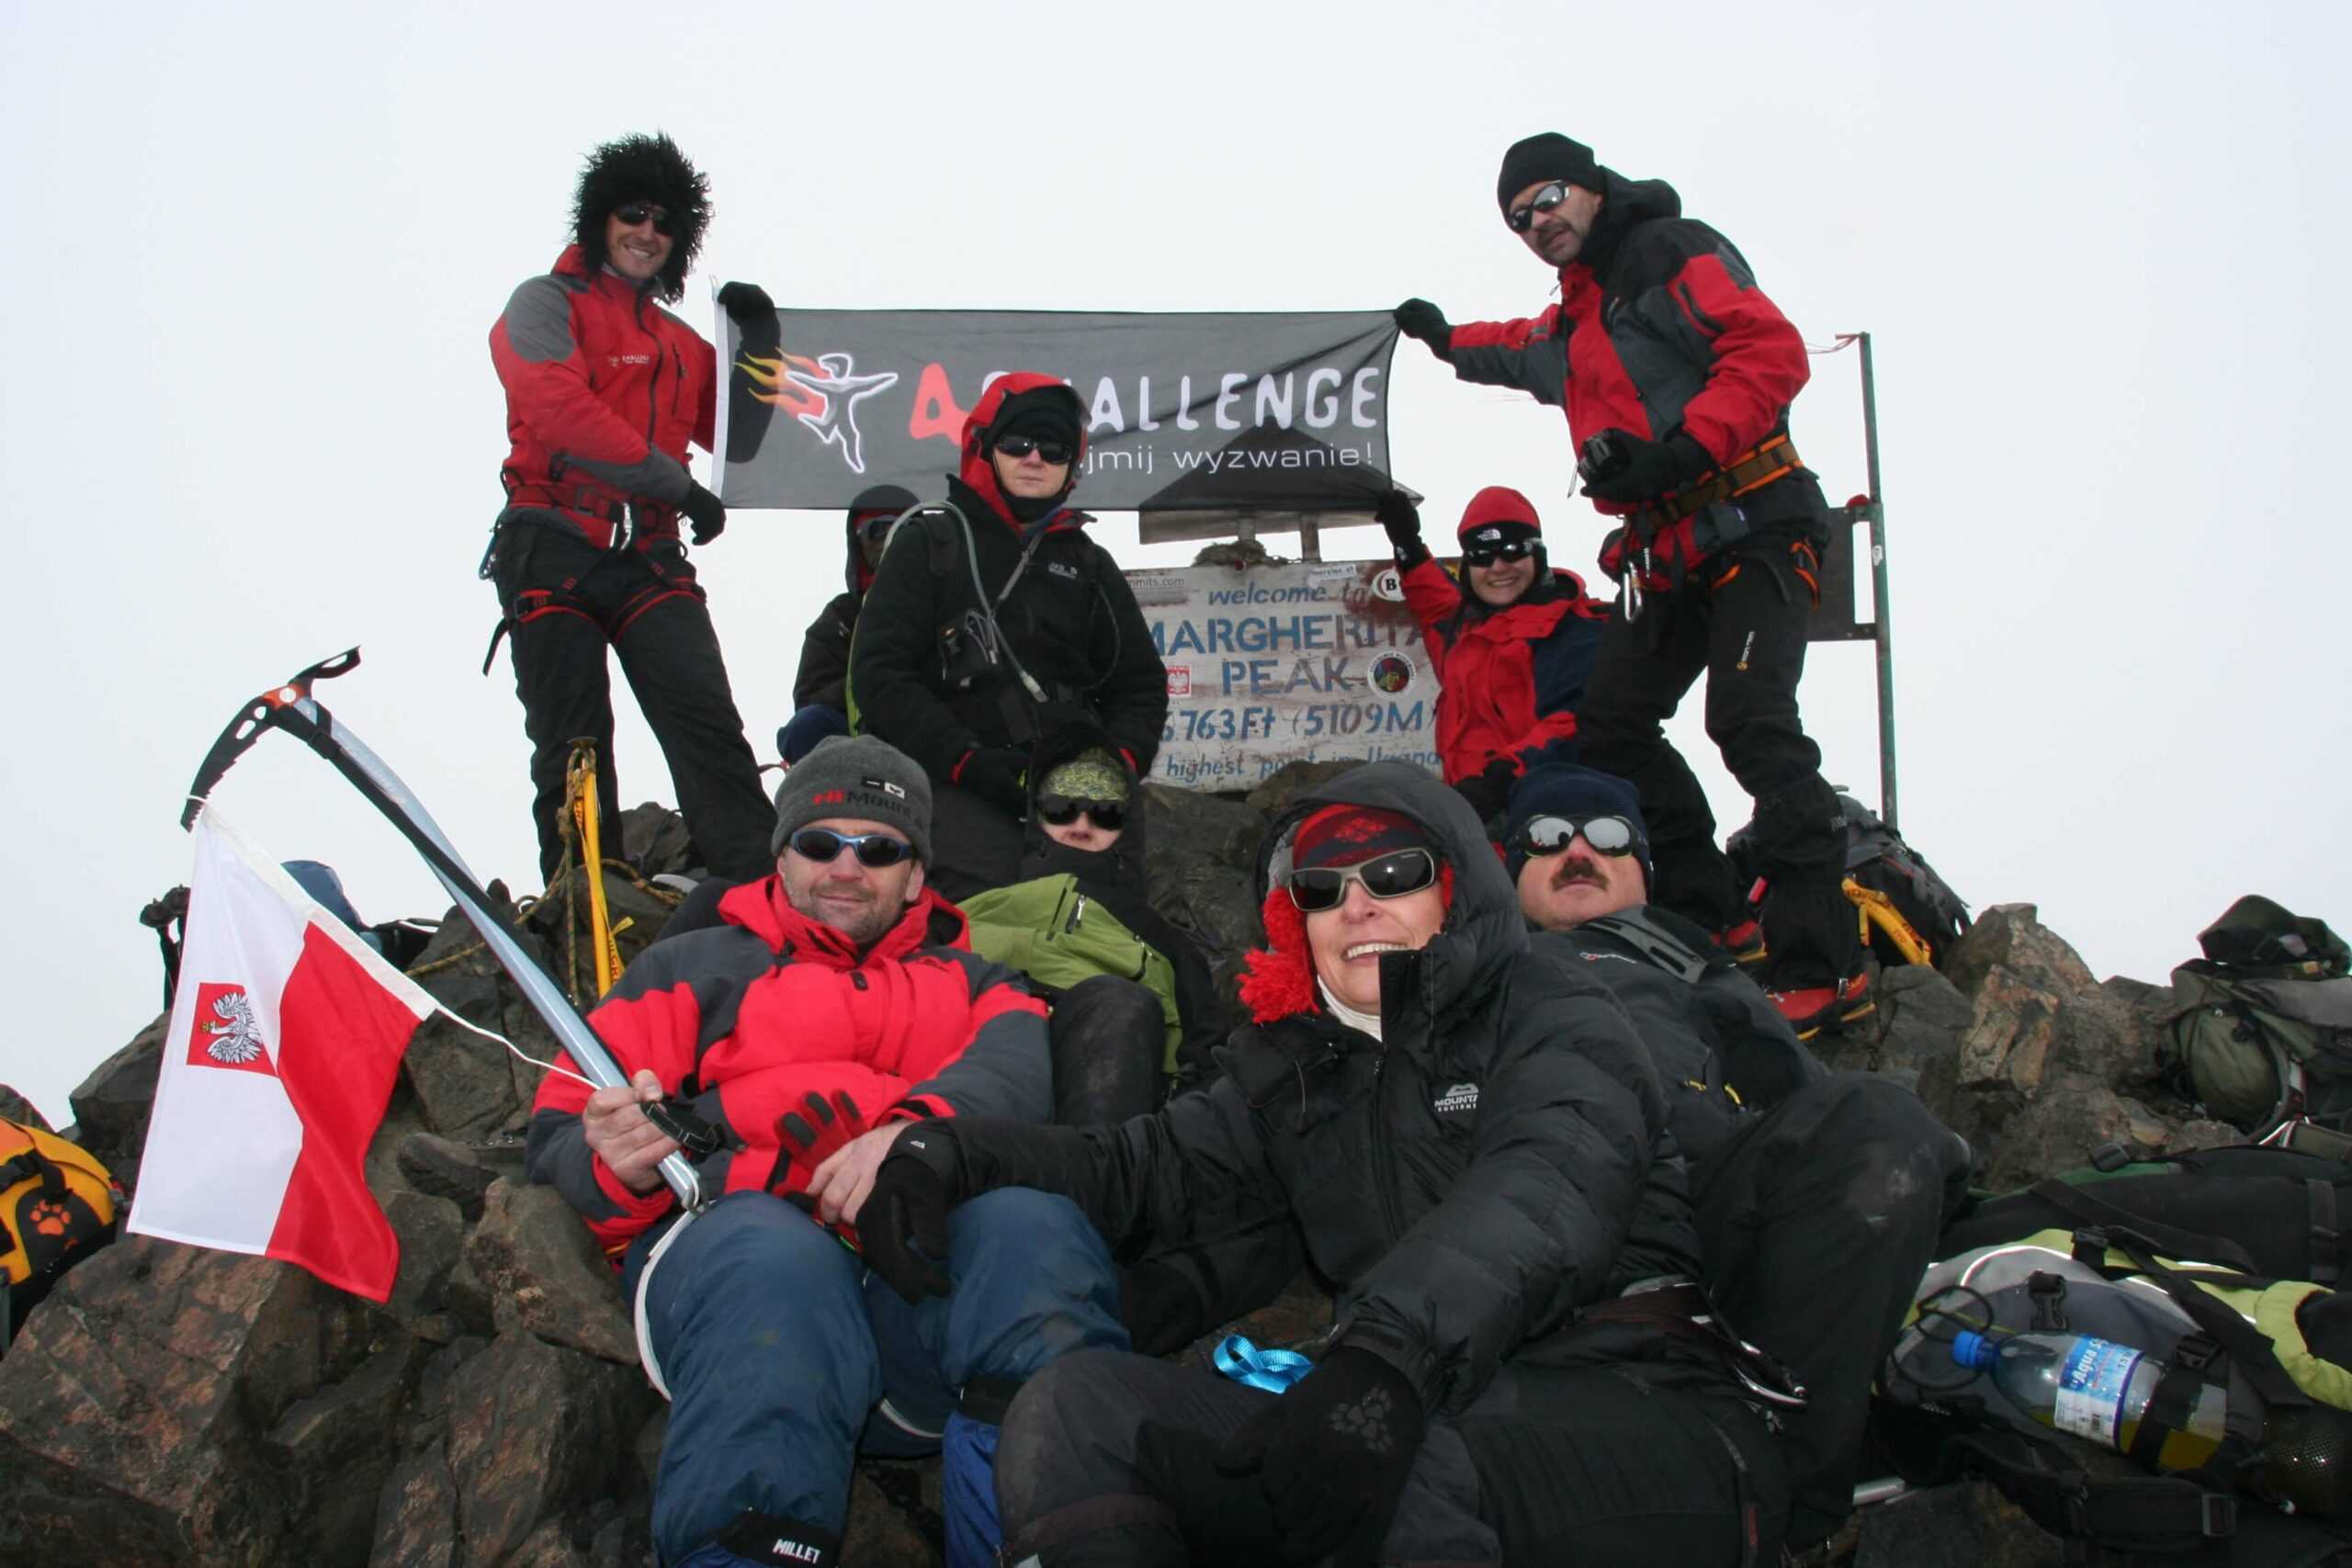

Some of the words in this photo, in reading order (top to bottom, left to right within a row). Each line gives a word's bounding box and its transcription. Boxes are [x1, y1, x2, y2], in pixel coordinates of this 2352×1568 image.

[982, 367, 1380, 432] ALLENGE
[1173, 444, 1374, 473] wyzwanie!
[1208, 581, 1328, 606] welcome
[1341, 582, 1367, 605] to
[1221, 656, 1349, 696] PEAK
[1166, 752, 1245, 784] highest
[2072, 1348, 2098, 1384] Aqua
[773, 1540, 821, 1564] MILLET
